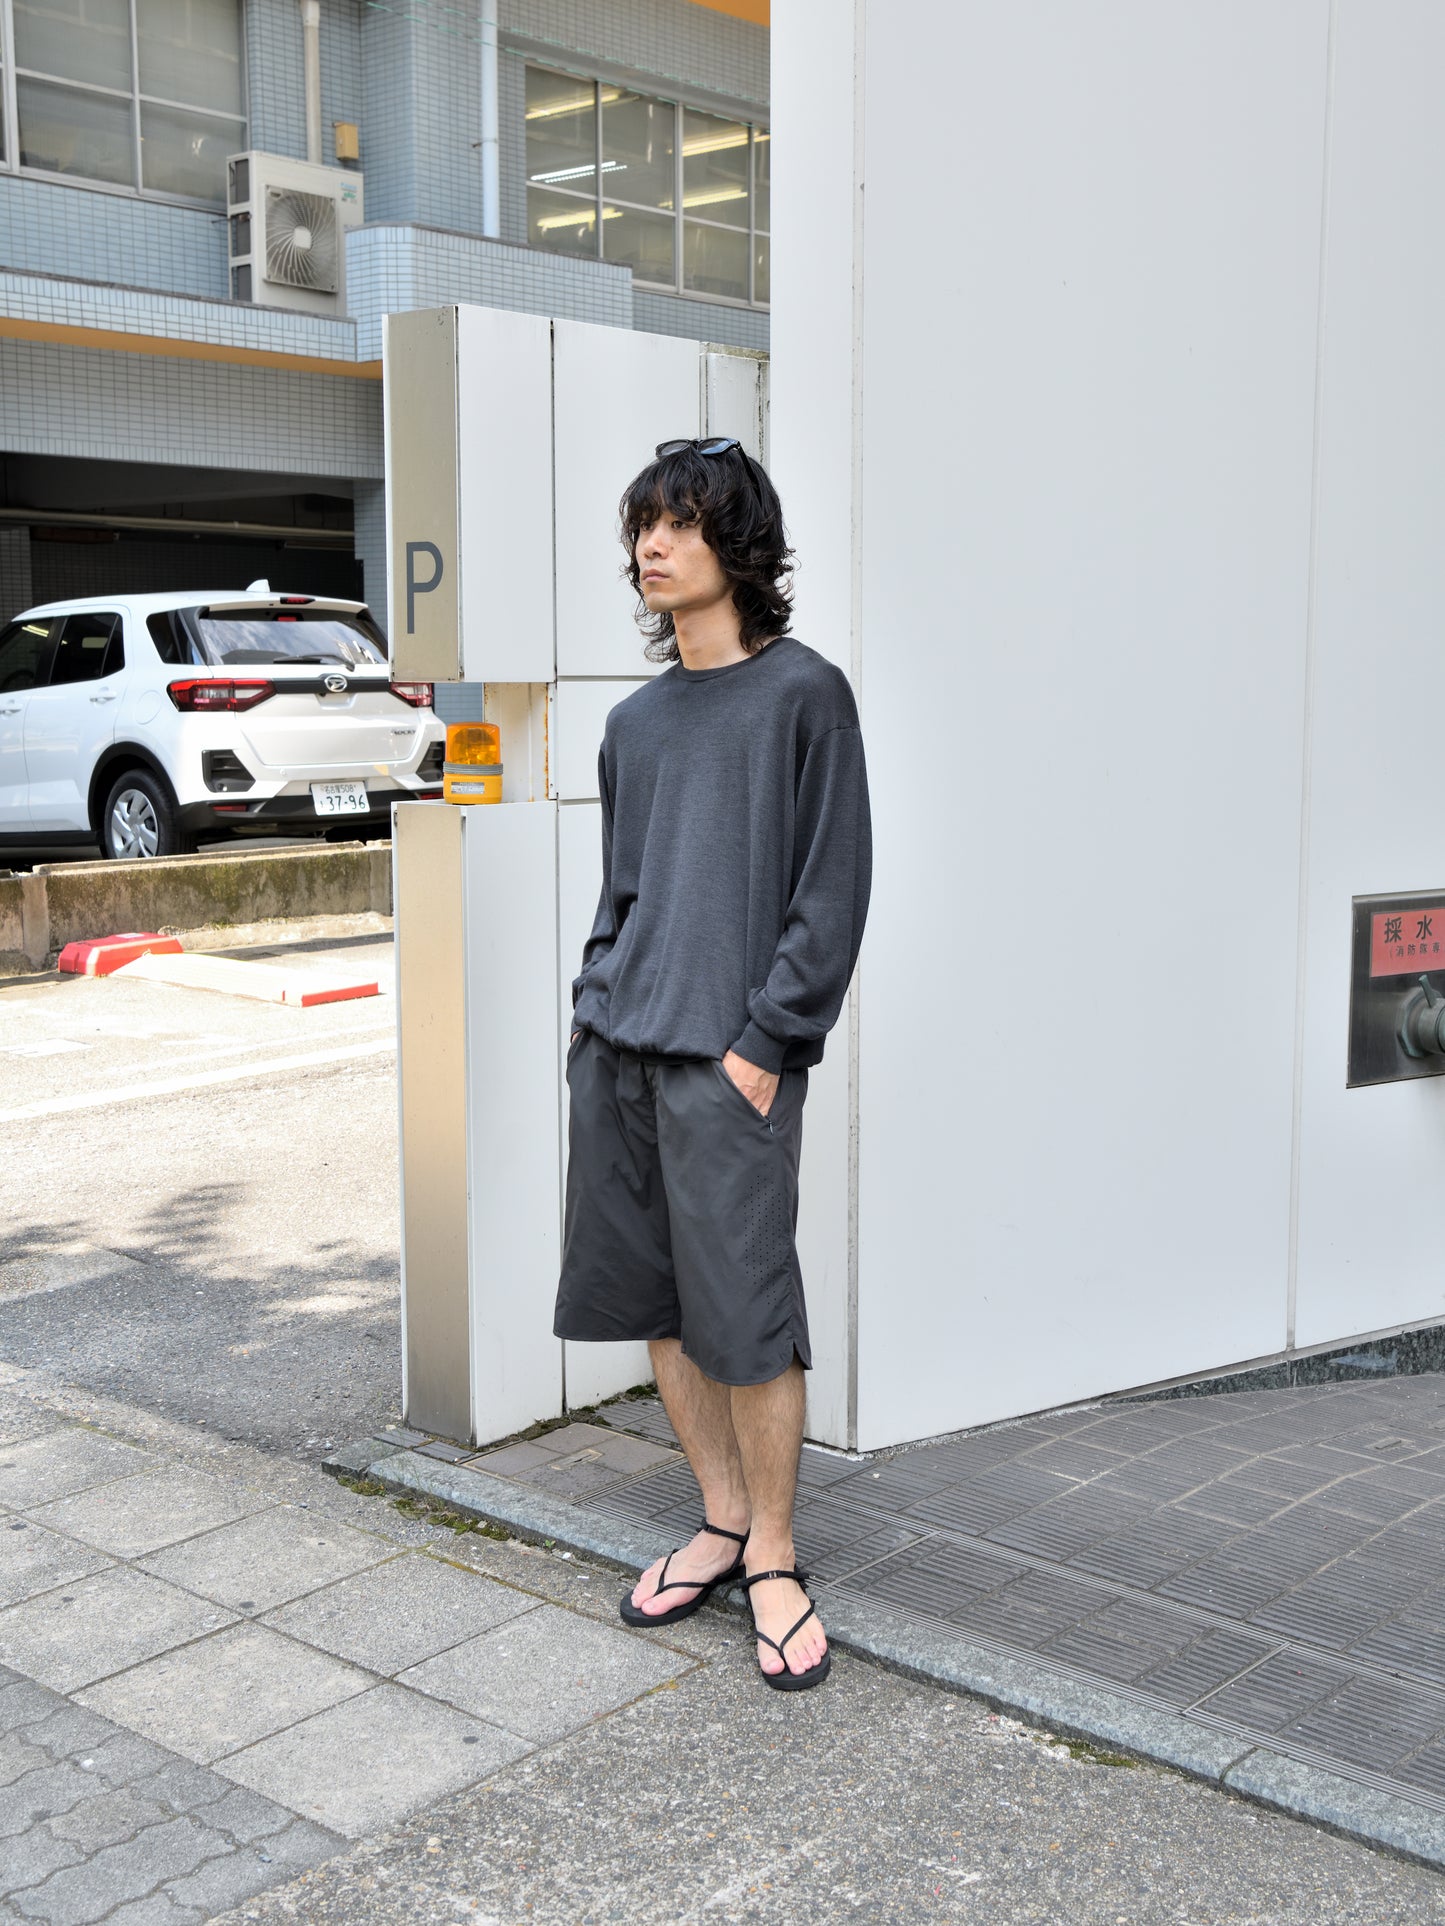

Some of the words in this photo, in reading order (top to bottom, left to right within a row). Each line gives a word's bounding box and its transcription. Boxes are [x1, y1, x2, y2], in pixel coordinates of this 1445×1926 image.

[406, 541, 444, 634] P
[326, 794, 366, 811] 37-96
[1384, 914, 1433, 944] 採水
